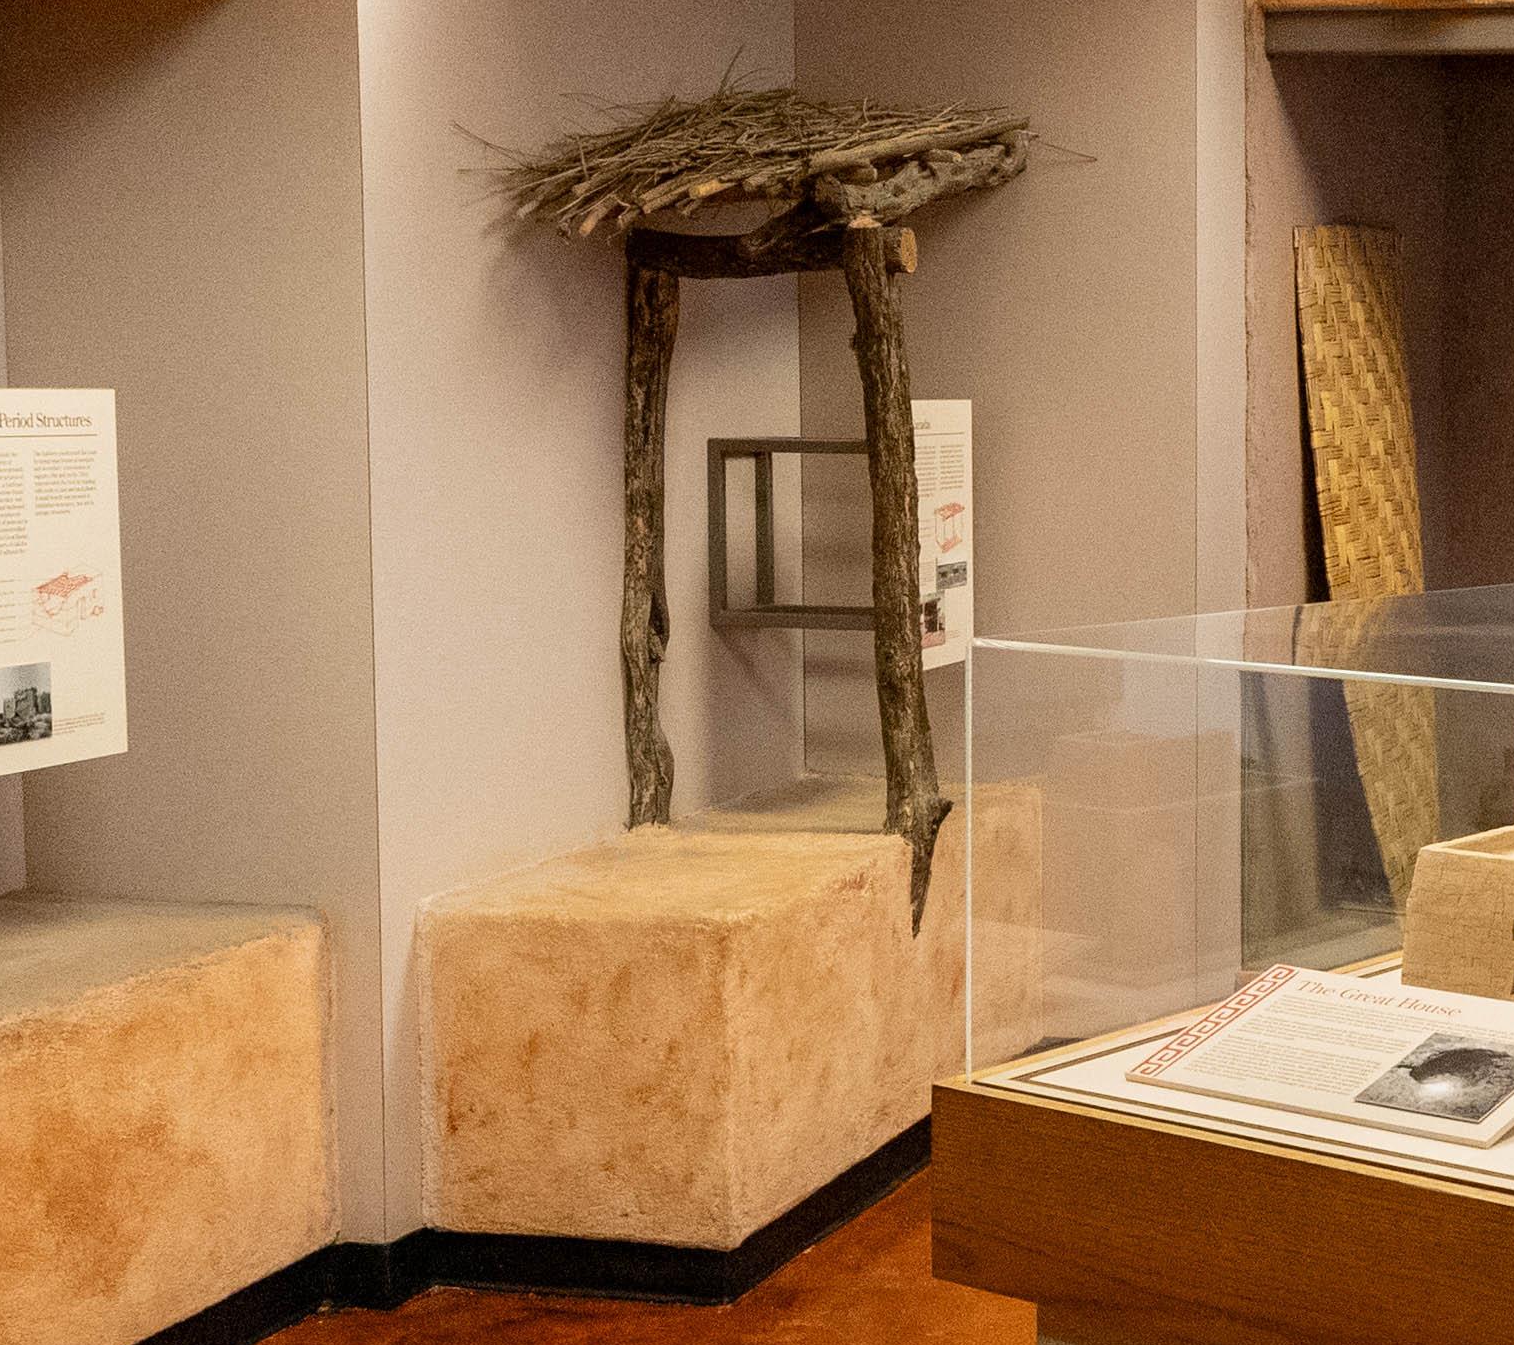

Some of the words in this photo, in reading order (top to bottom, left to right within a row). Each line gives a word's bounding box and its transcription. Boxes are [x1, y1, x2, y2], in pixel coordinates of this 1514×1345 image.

[36, 412, 92, 428] Structures
[1297, 979, 1336, 997] The
[1339, 988, 1396, 1006] Great
[1397, 997, 1462, 1017] House
